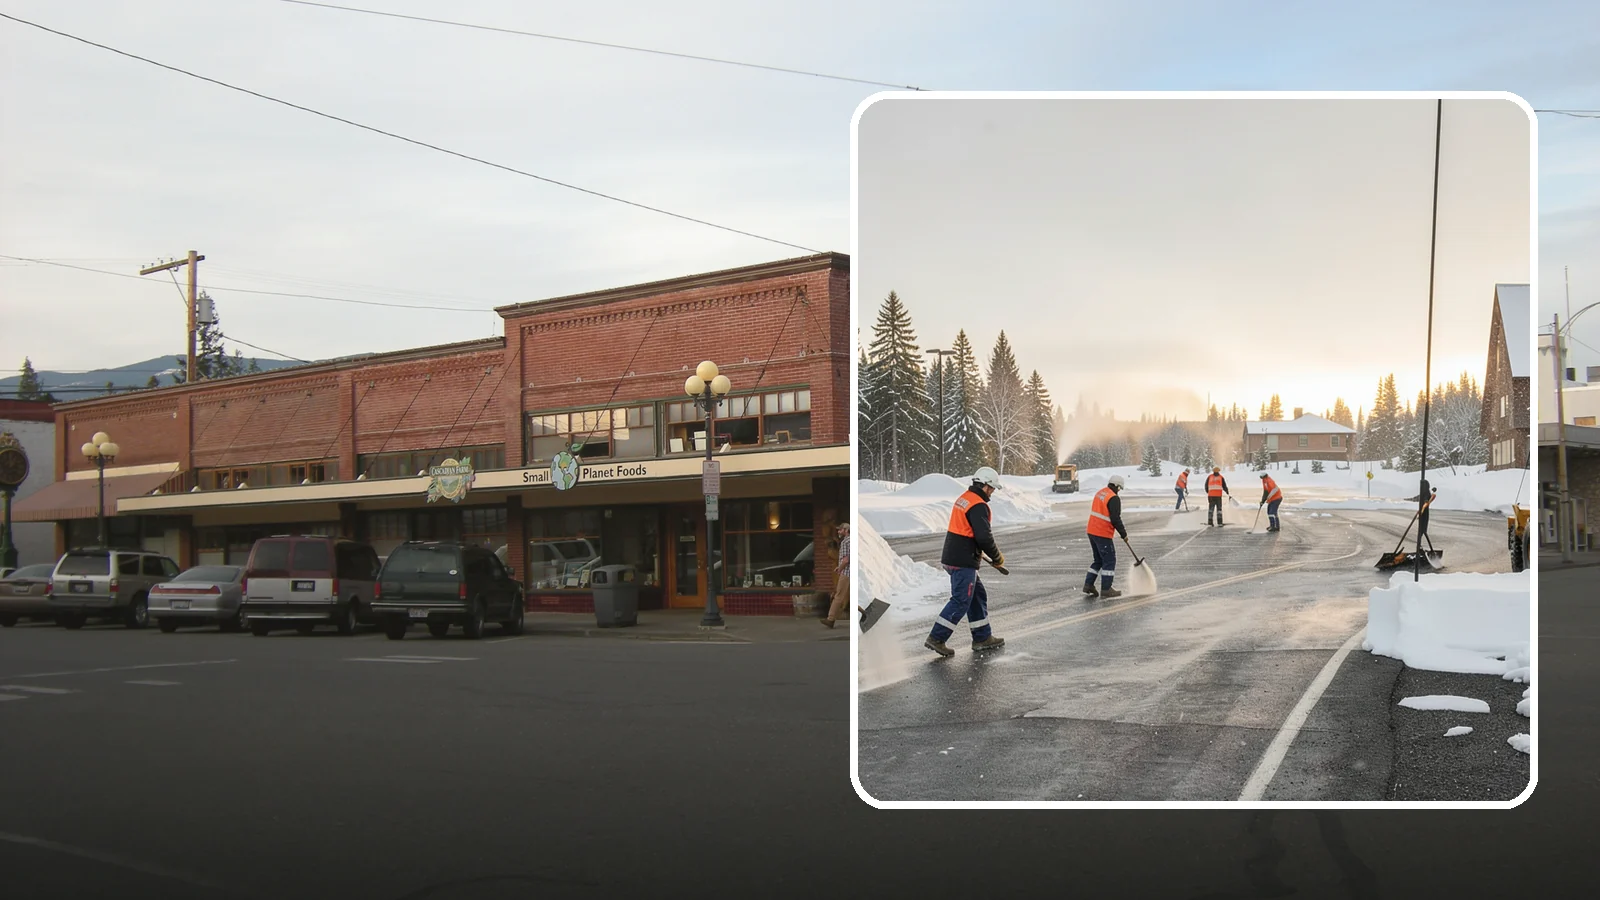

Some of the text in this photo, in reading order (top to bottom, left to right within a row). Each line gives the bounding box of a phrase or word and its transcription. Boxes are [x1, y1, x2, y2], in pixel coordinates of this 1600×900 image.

[523, 464, 647, 483] Small Planet Foods
